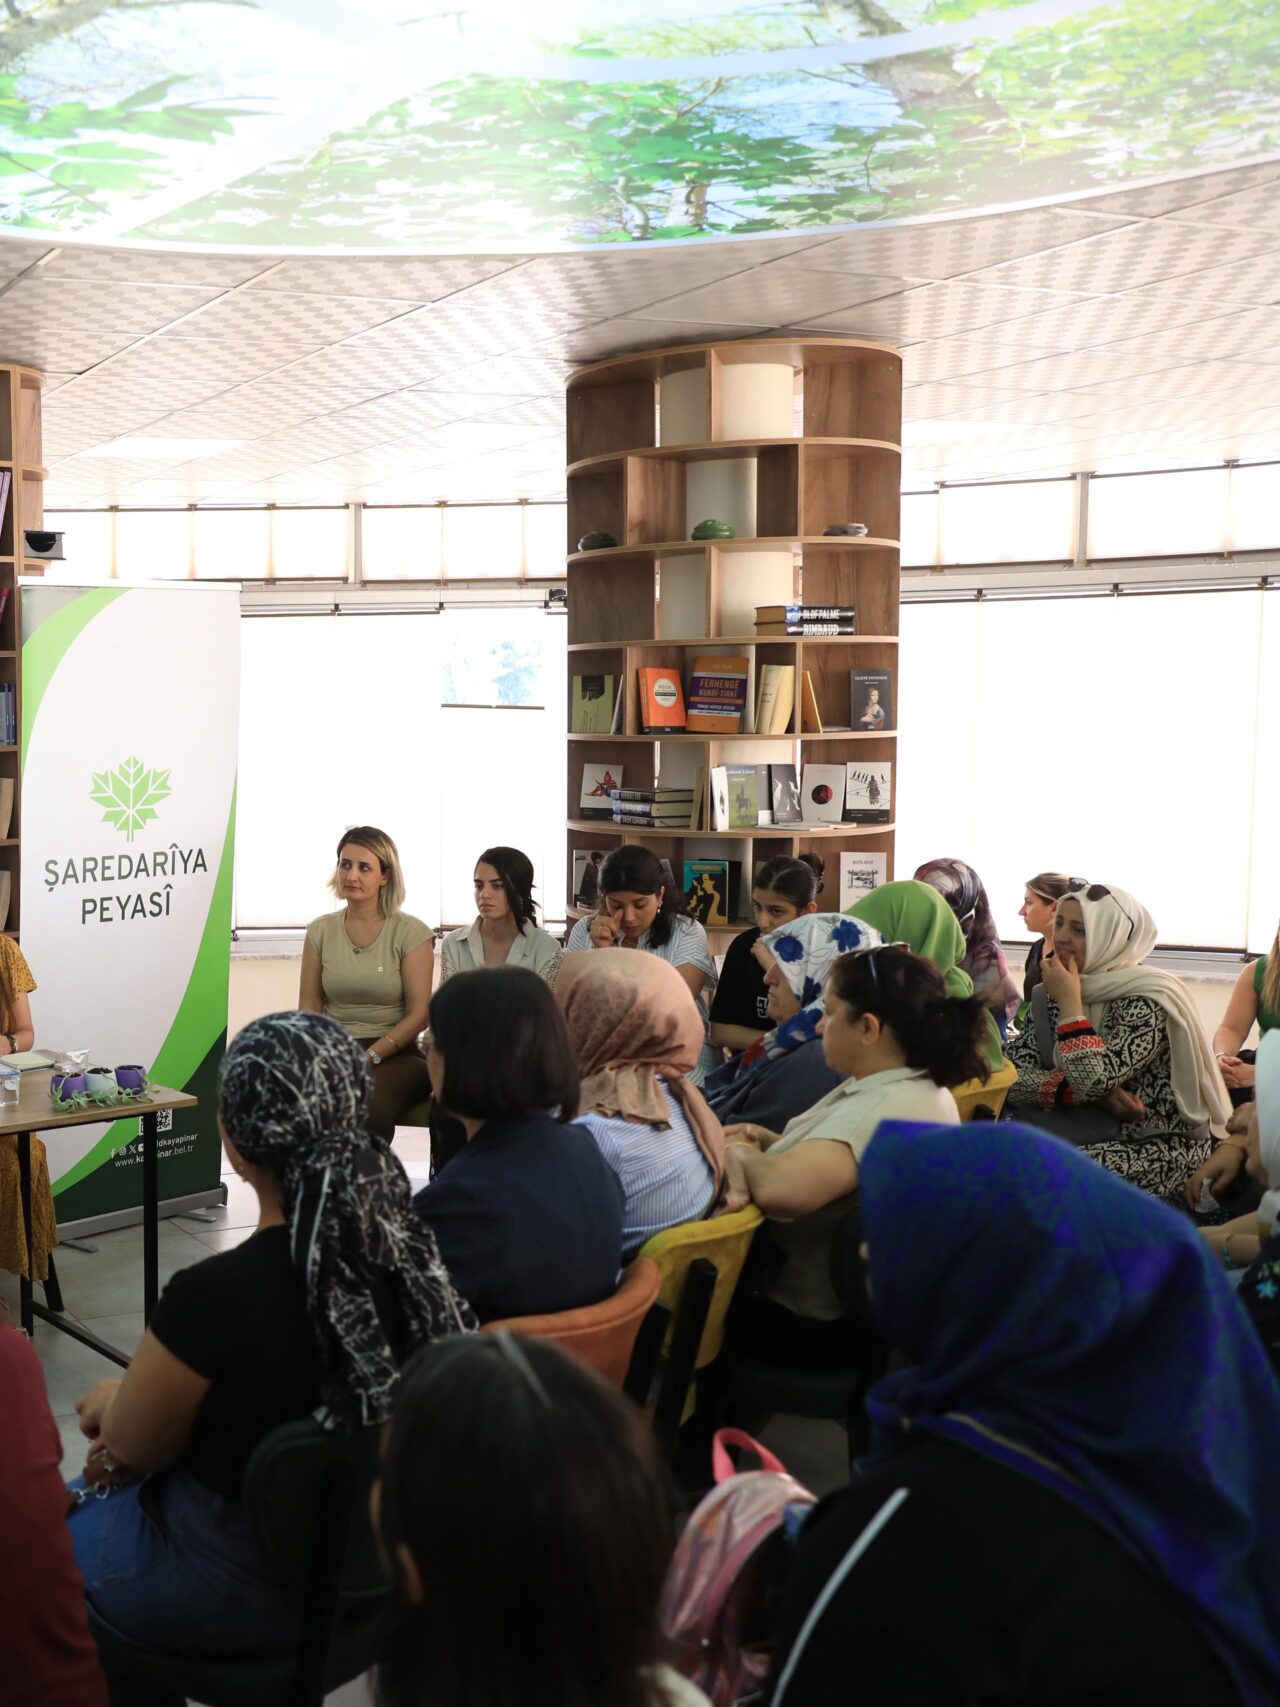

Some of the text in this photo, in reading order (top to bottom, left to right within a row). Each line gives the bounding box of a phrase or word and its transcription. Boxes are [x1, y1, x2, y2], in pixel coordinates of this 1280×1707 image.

[818, 609, 840, 619] PALME
[802, 624, 839, 636] RIMBAUD
[43, 842, 208, 892] ŞAREDARÎYA
[81, 883, 173, 925] PEYASÎ
